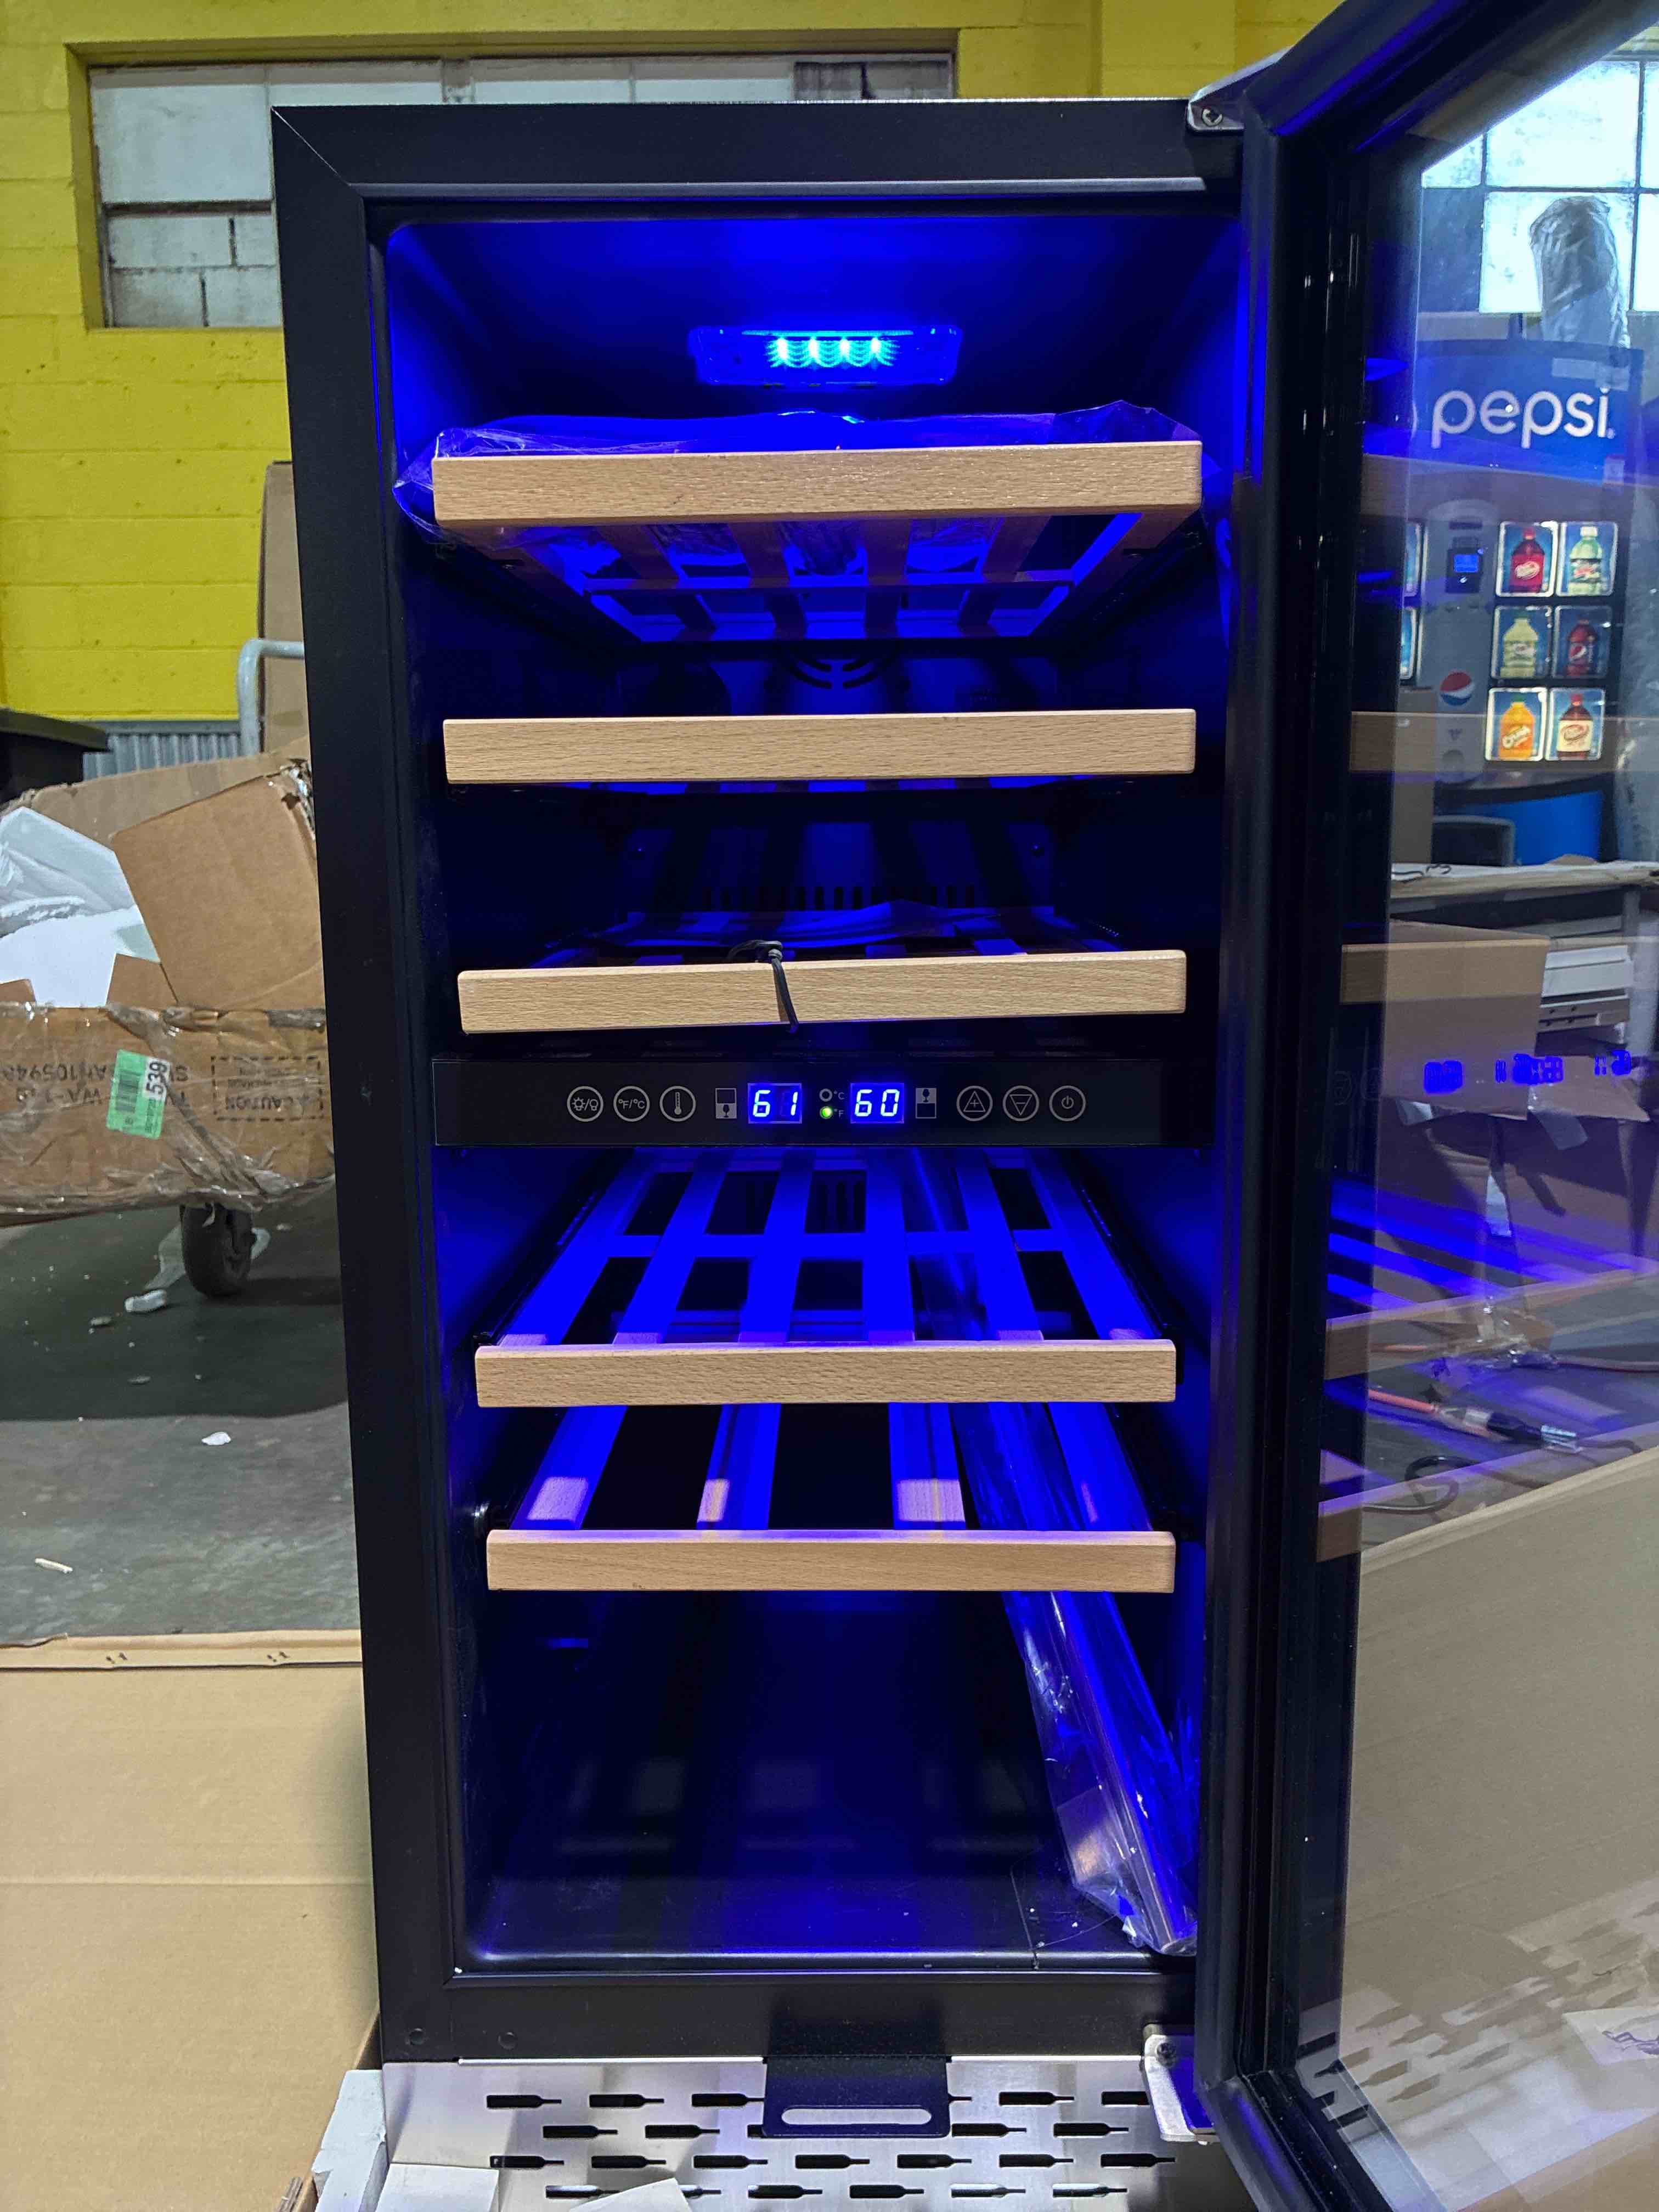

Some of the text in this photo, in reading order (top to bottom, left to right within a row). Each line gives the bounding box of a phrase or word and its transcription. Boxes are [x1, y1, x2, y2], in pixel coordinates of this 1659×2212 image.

[1431, 387, 1608, 449] pepsi
[145, 1060, 167, 1096] 539
[752, 1090, 798, 1118] 61
[854, 1089, 900, 1117] 60
